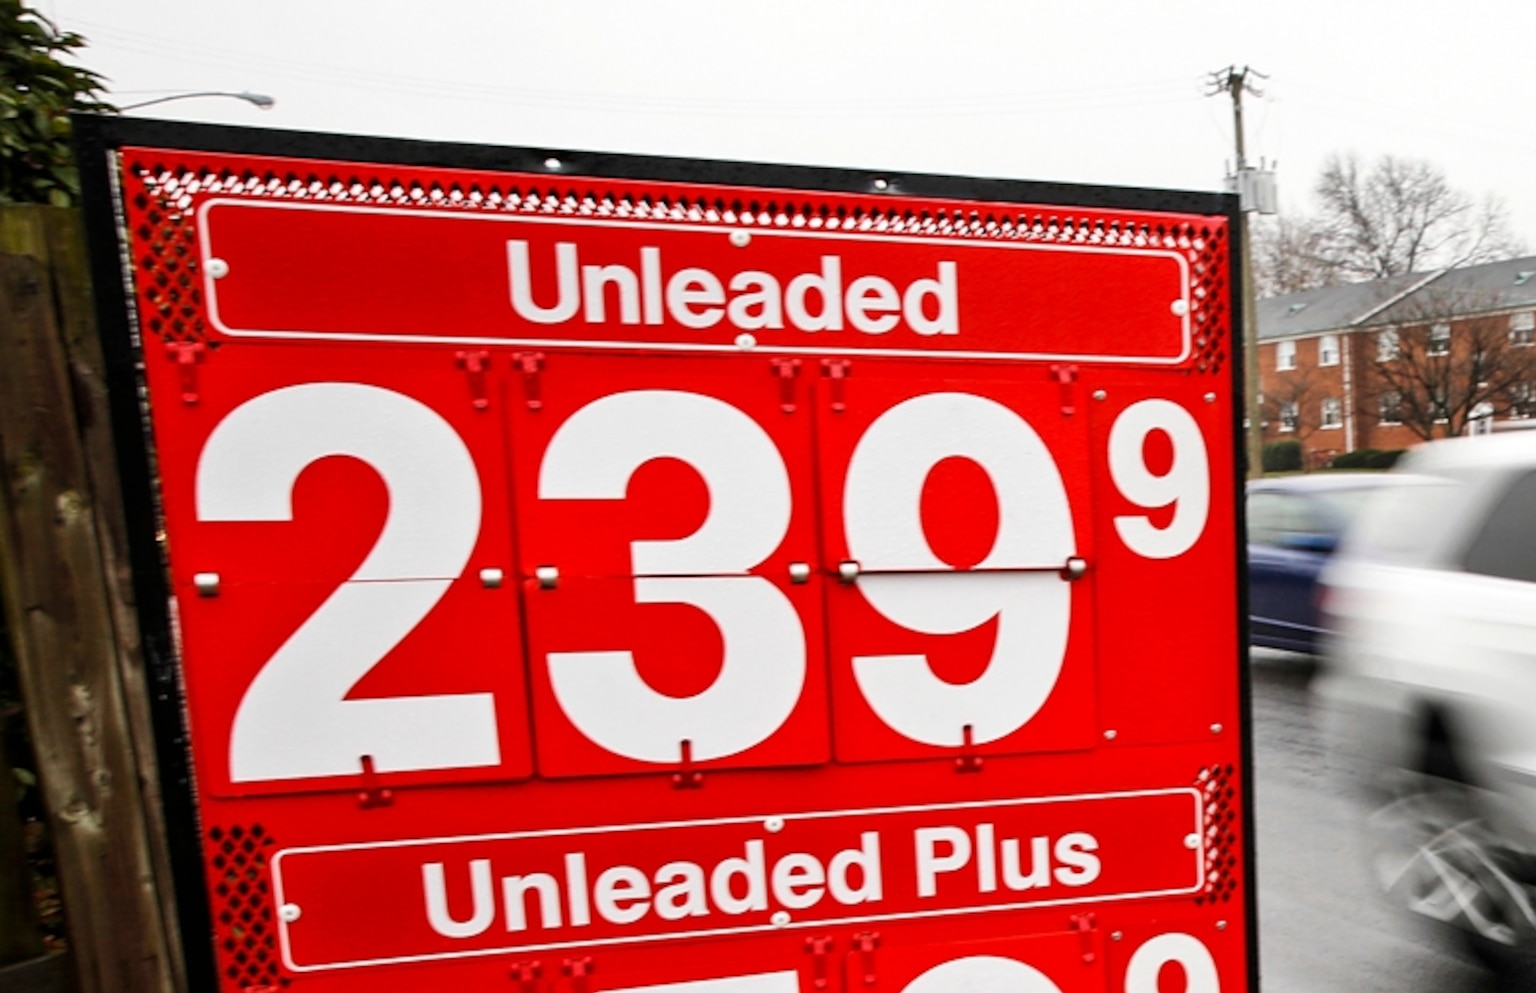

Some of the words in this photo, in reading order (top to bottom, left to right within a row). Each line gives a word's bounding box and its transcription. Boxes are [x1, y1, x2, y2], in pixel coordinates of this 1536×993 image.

[507, 240, 959, 336] Unleaded
[422, 831, 883, 939] Unleaded
[914, 822, 1101, 898] Plus
